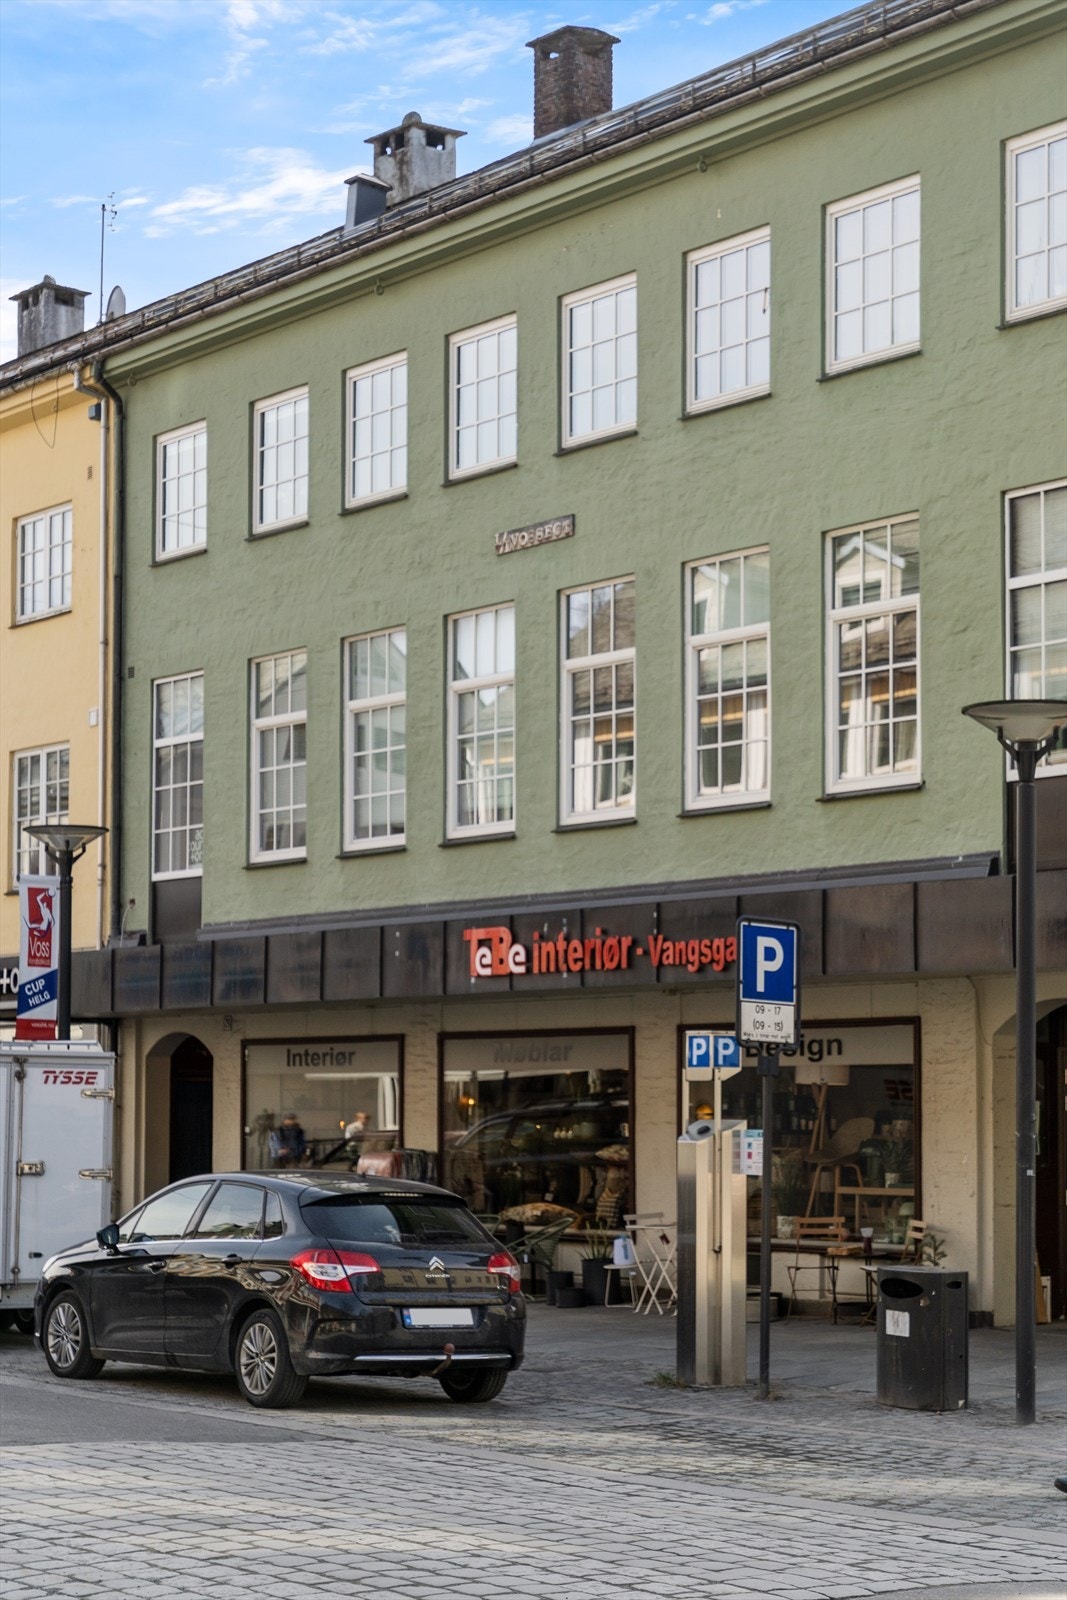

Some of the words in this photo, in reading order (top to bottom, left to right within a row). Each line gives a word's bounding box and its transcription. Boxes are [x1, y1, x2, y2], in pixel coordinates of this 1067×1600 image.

[29, 936, 50, 958] Voss
[463, 926, 526, 977] TeBe
[532, 927, 632, 974] interiør
[756, 936, 784, 992] P
[24, 978, 46, 996] CUP
[28, 991, 51, 1007] HELG
[755, 1005, 765, 1015] 09
[774, 1006, 781, 1015] 17
[286, 1047, 355, 1067] Interiør
[692, 1037, 707, 1066] P
[717, 1037, 735, 1066] P
[42, 1070, 98, 1085] TYSSE
